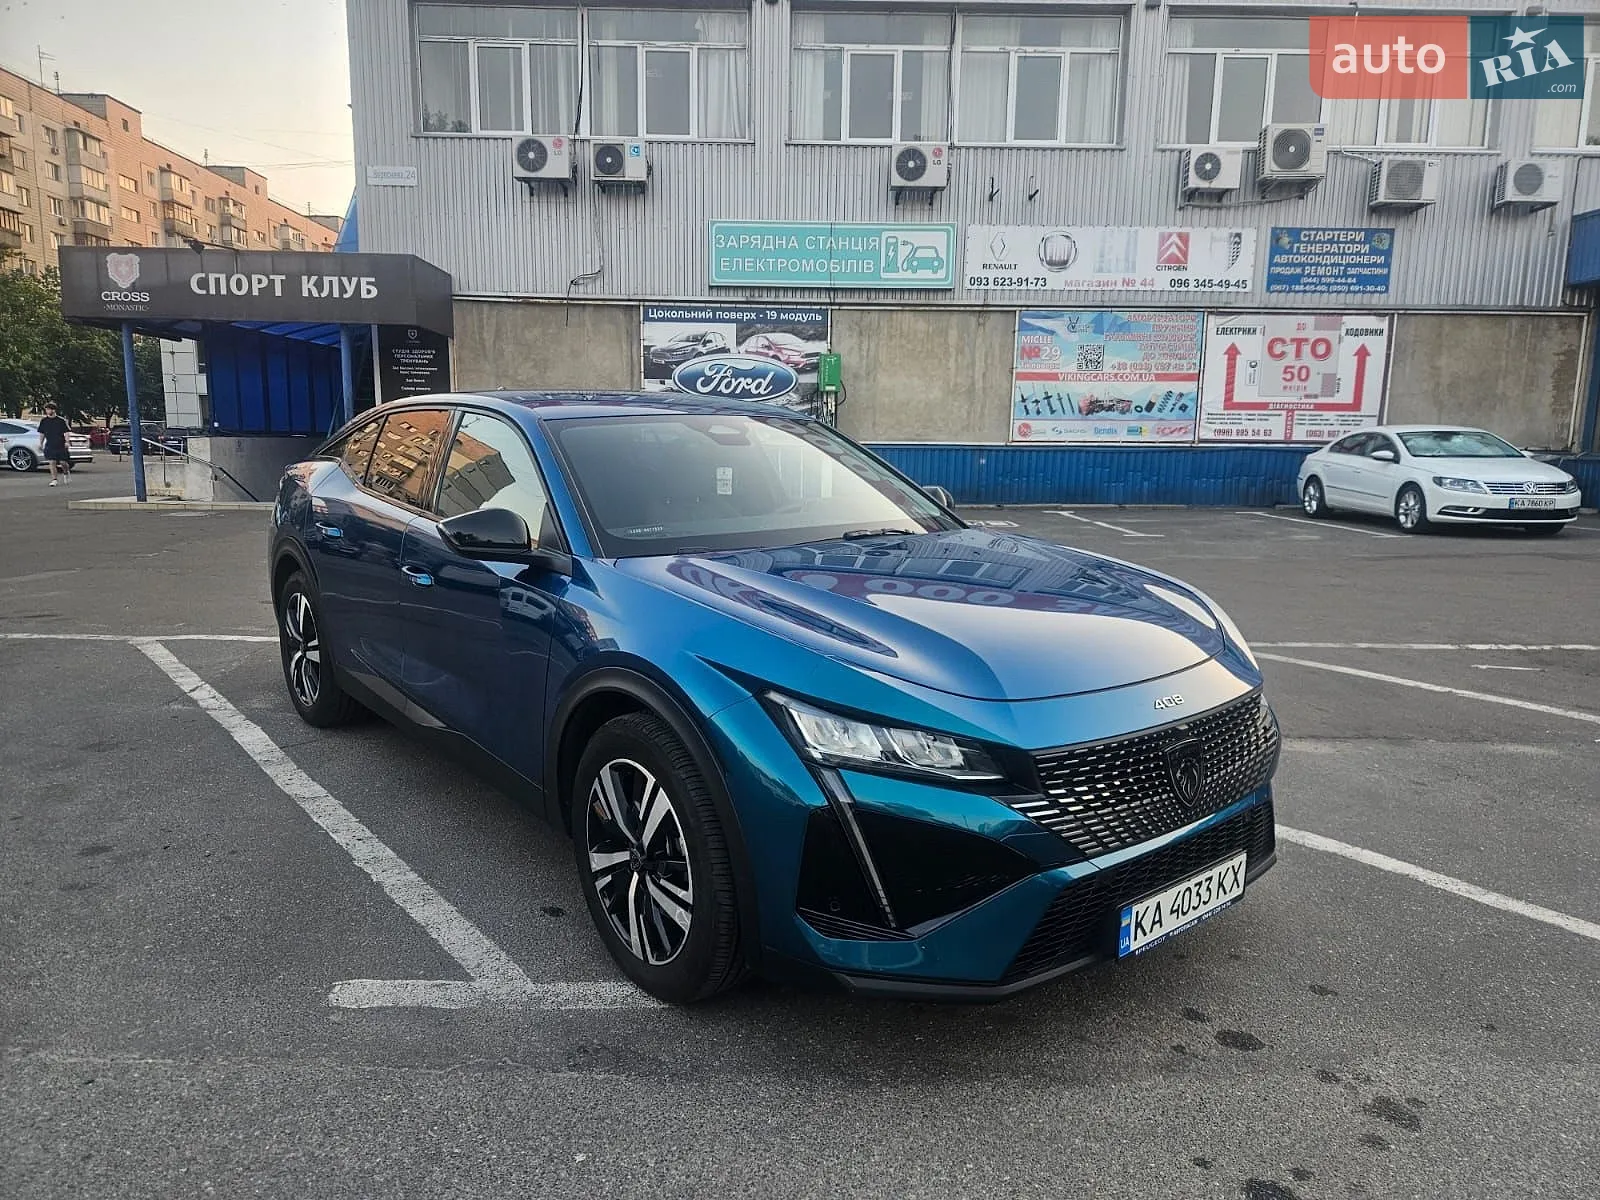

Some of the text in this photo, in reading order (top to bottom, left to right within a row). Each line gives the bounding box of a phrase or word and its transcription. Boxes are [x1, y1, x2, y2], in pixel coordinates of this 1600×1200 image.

[1300, 231, 1365, 241] СТАРТЕРИ
[715, 234, 880, 252] ЗАРЯДНА СТАНЦІЯ
[1293, 243, 1370, 254] ГЕНЕРАТОРИ
[1274, 255, 1385, 265] АВТОКОНДИЦІОНЕРИ
[720, 258, 875, 274] ЕЛЕКТРОМОБІЛІВ
[1304, 266, 1345, 275] РЕМОНТ
[190, 272, 379, 299] СПОРТ КЛУБ
[969, 277, 1047, 288] 093 623-91-73
[1064, 279, 1117, 288] магазин
[1140, 278, 1155, 288] 44
[1169, 279, 1248, 289] 096 345-49-45
[101, 291, 150, 302] CROSS
[648, 308, 713, 322] Цокольний
[715, 310, 757, 323] поверх
[766, 310, 778, 321] 19
[780, 311, 823, 322] модуль
[1215, 327, 1257, 336] ЕЛЕКТРИКИ
[1345, 328, 1384, 337] ХОДОВИКИ
[1267, 337, 1332, 361] СТО
[1057, 373, 1156, 382] VIKINGCARS.COM.UA
[1282, 365, 1310, 382] 50
[696, 362, 774, 397] Ford
[1154, 694, 1184, 710] 408
[1134, 900, 1163, 941] KA
[1169, 875, 1214, 921] 4033
[1216, 861, 1243, 900] KX
[1120, 937, 1130, 949] UA
